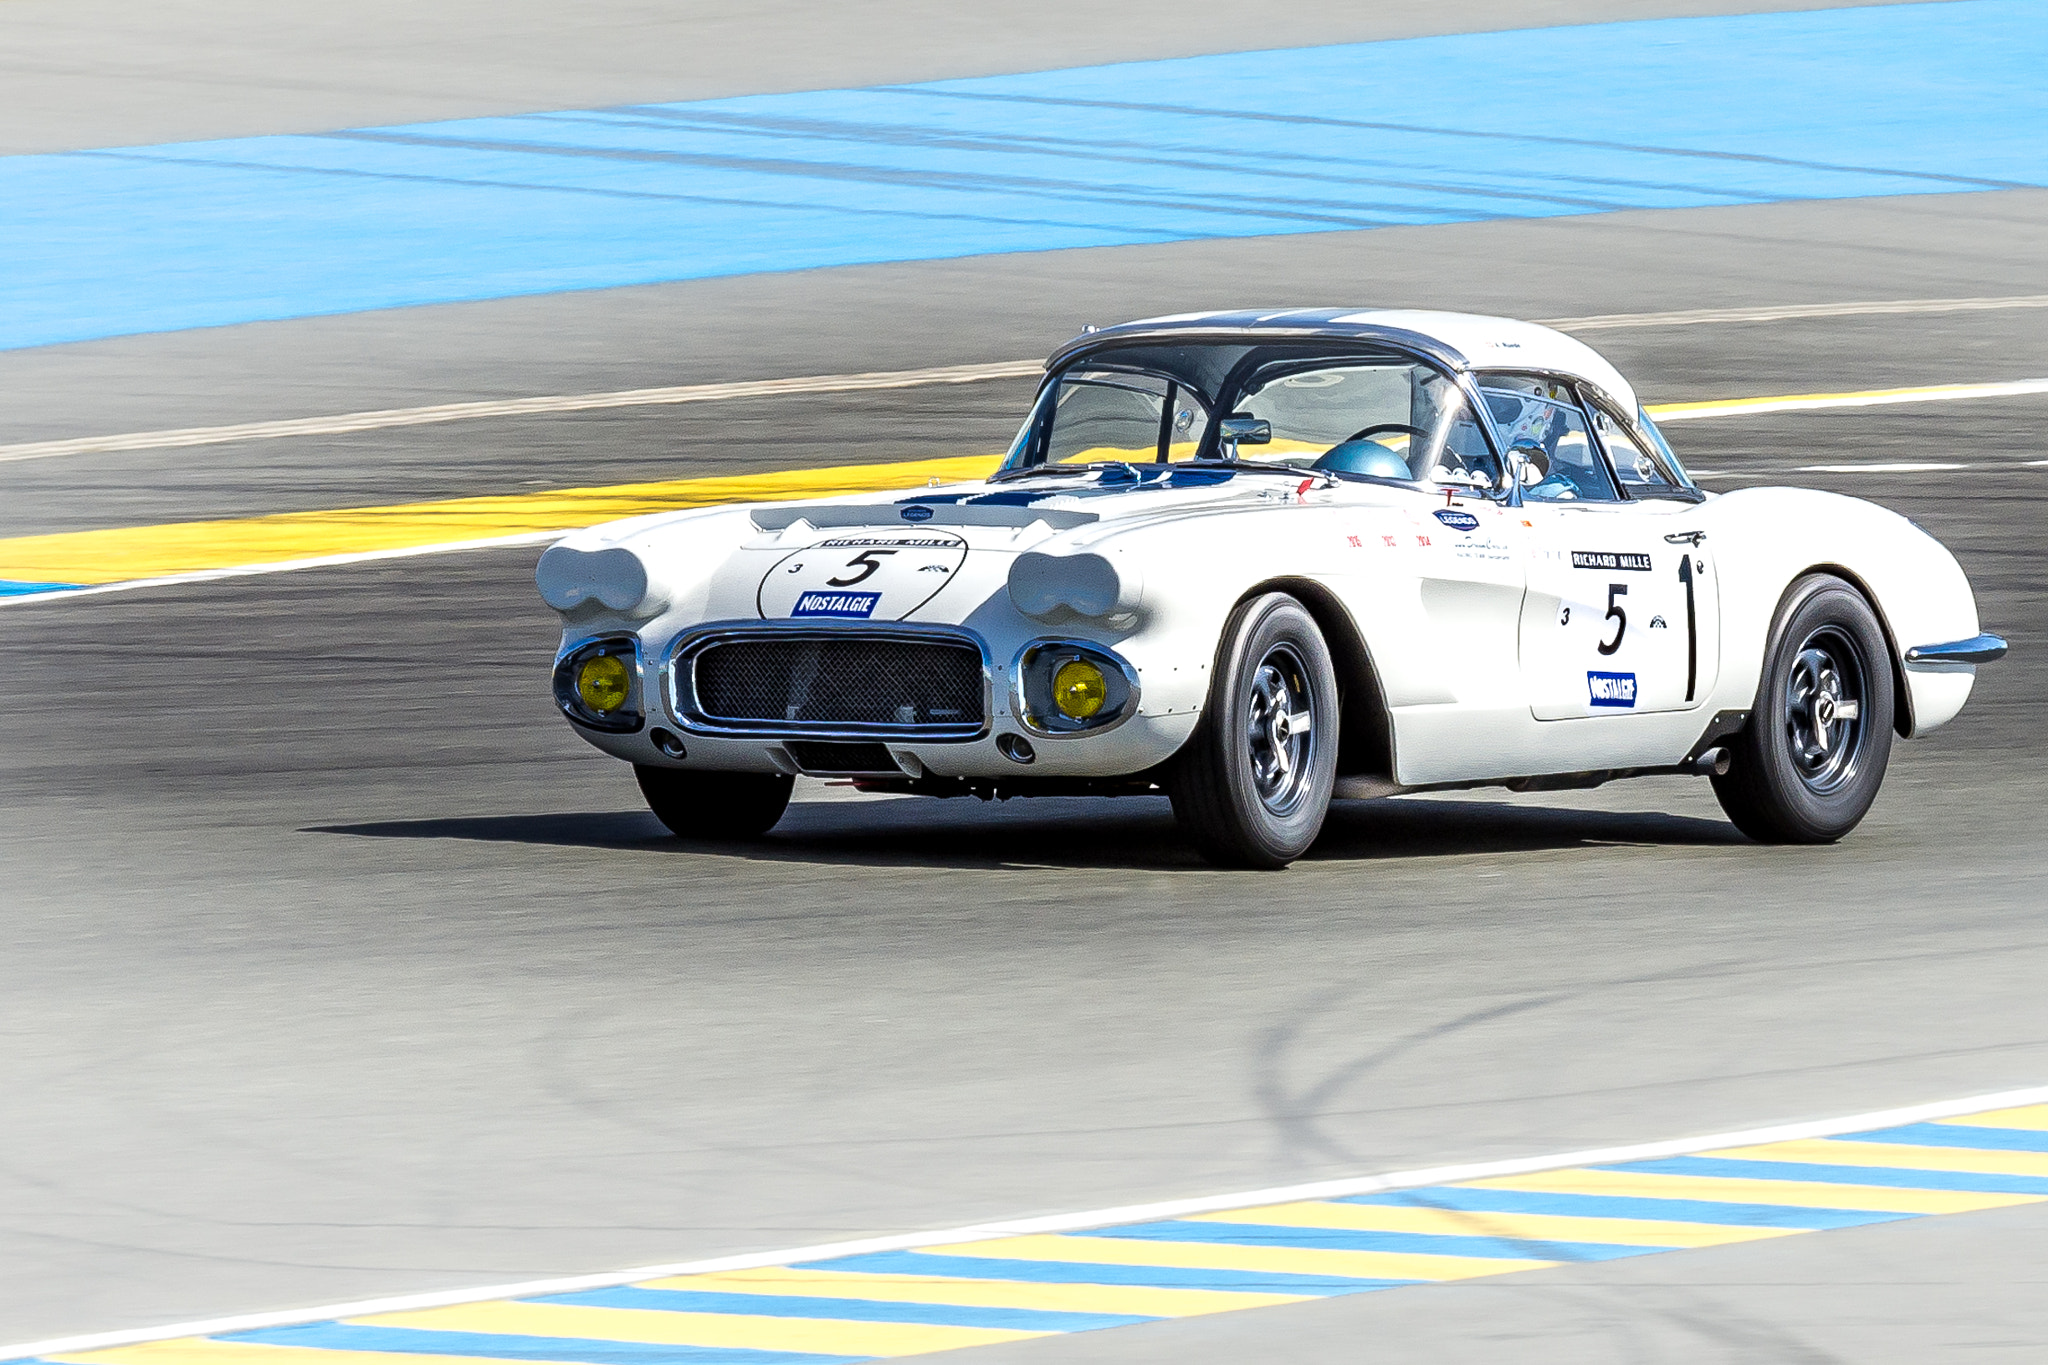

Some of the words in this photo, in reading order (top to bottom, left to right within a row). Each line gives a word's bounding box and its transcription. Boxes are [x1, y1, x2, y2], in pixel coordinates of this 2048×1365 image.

[825, 539, 900, 547] RICHARD
[905, 539, 958, 547] MILLE
[788, 563, 803, 574] 3
[826, 550, 899, 587] 5
[1572, 553, 1617, 568] RICHARD
[1619, 555, 1651, 569] MILLE
[799, 595, 874, 612] NOSTALGIE
[1561, 607, 1571, 626] 3
[1598, 583, 1628, 656] 5
